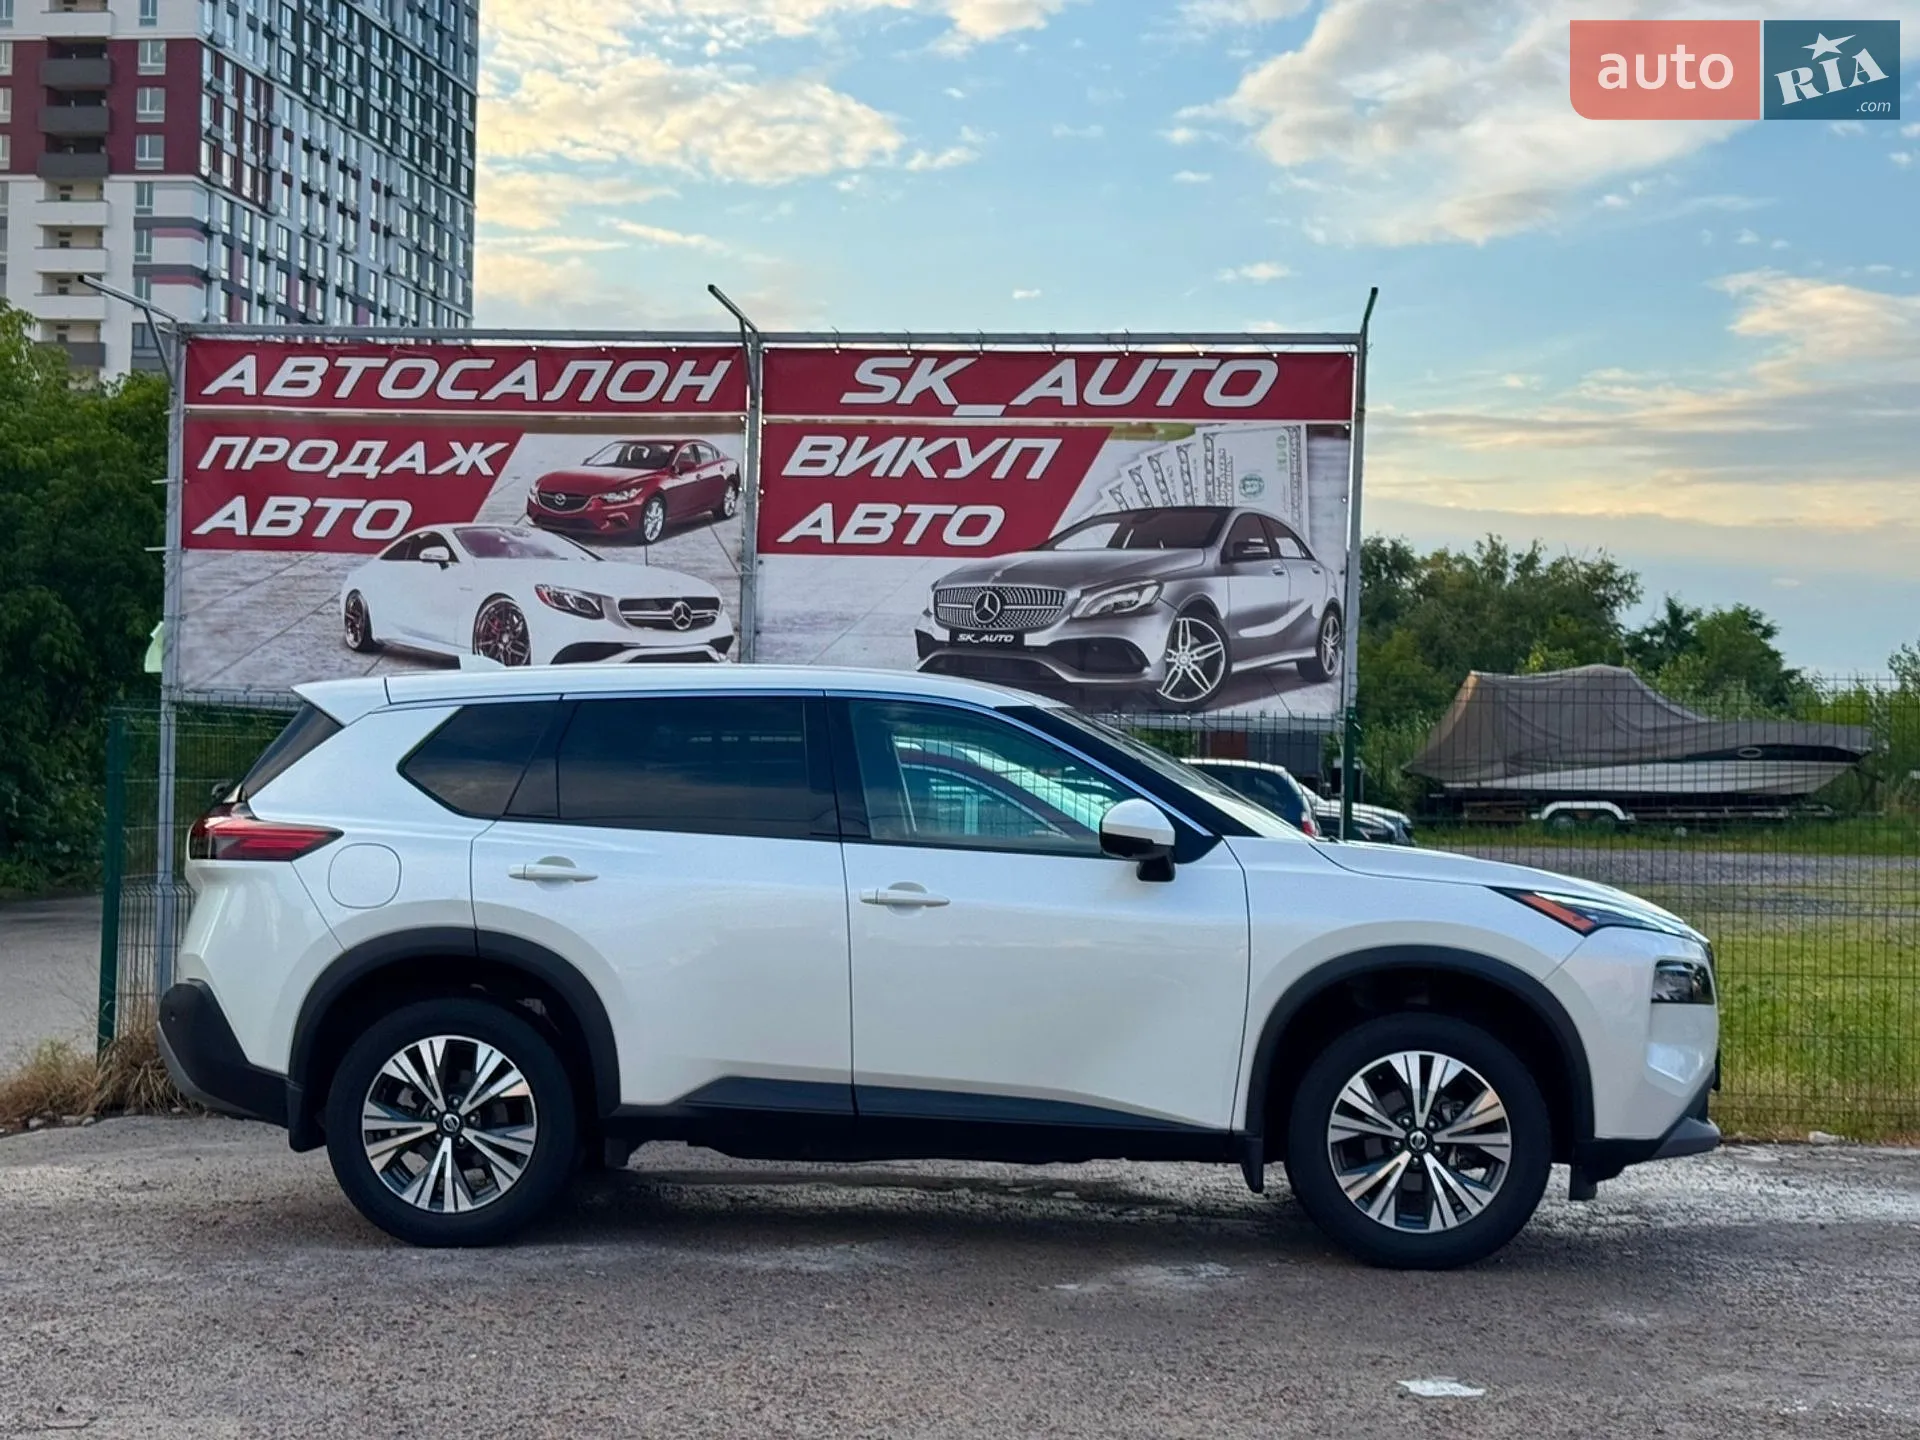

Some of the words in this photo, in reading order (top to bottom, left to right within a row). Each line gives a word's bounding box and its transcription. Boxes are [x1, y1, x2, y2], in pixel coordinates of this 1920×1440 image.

[201, 354, 731, 403] АВТОСАЛОН
[840, 357, 1279, 416] SK_AUTO
[197, 436, 509, 479] ПРОДАЖ
[780, 436, 1063, 480] ВИКУП
[191, 496, 413, 540] АВТО
[777, 503, 1006, 546] АВТО
[957, 633, 1015, 643] SK_AUTO
